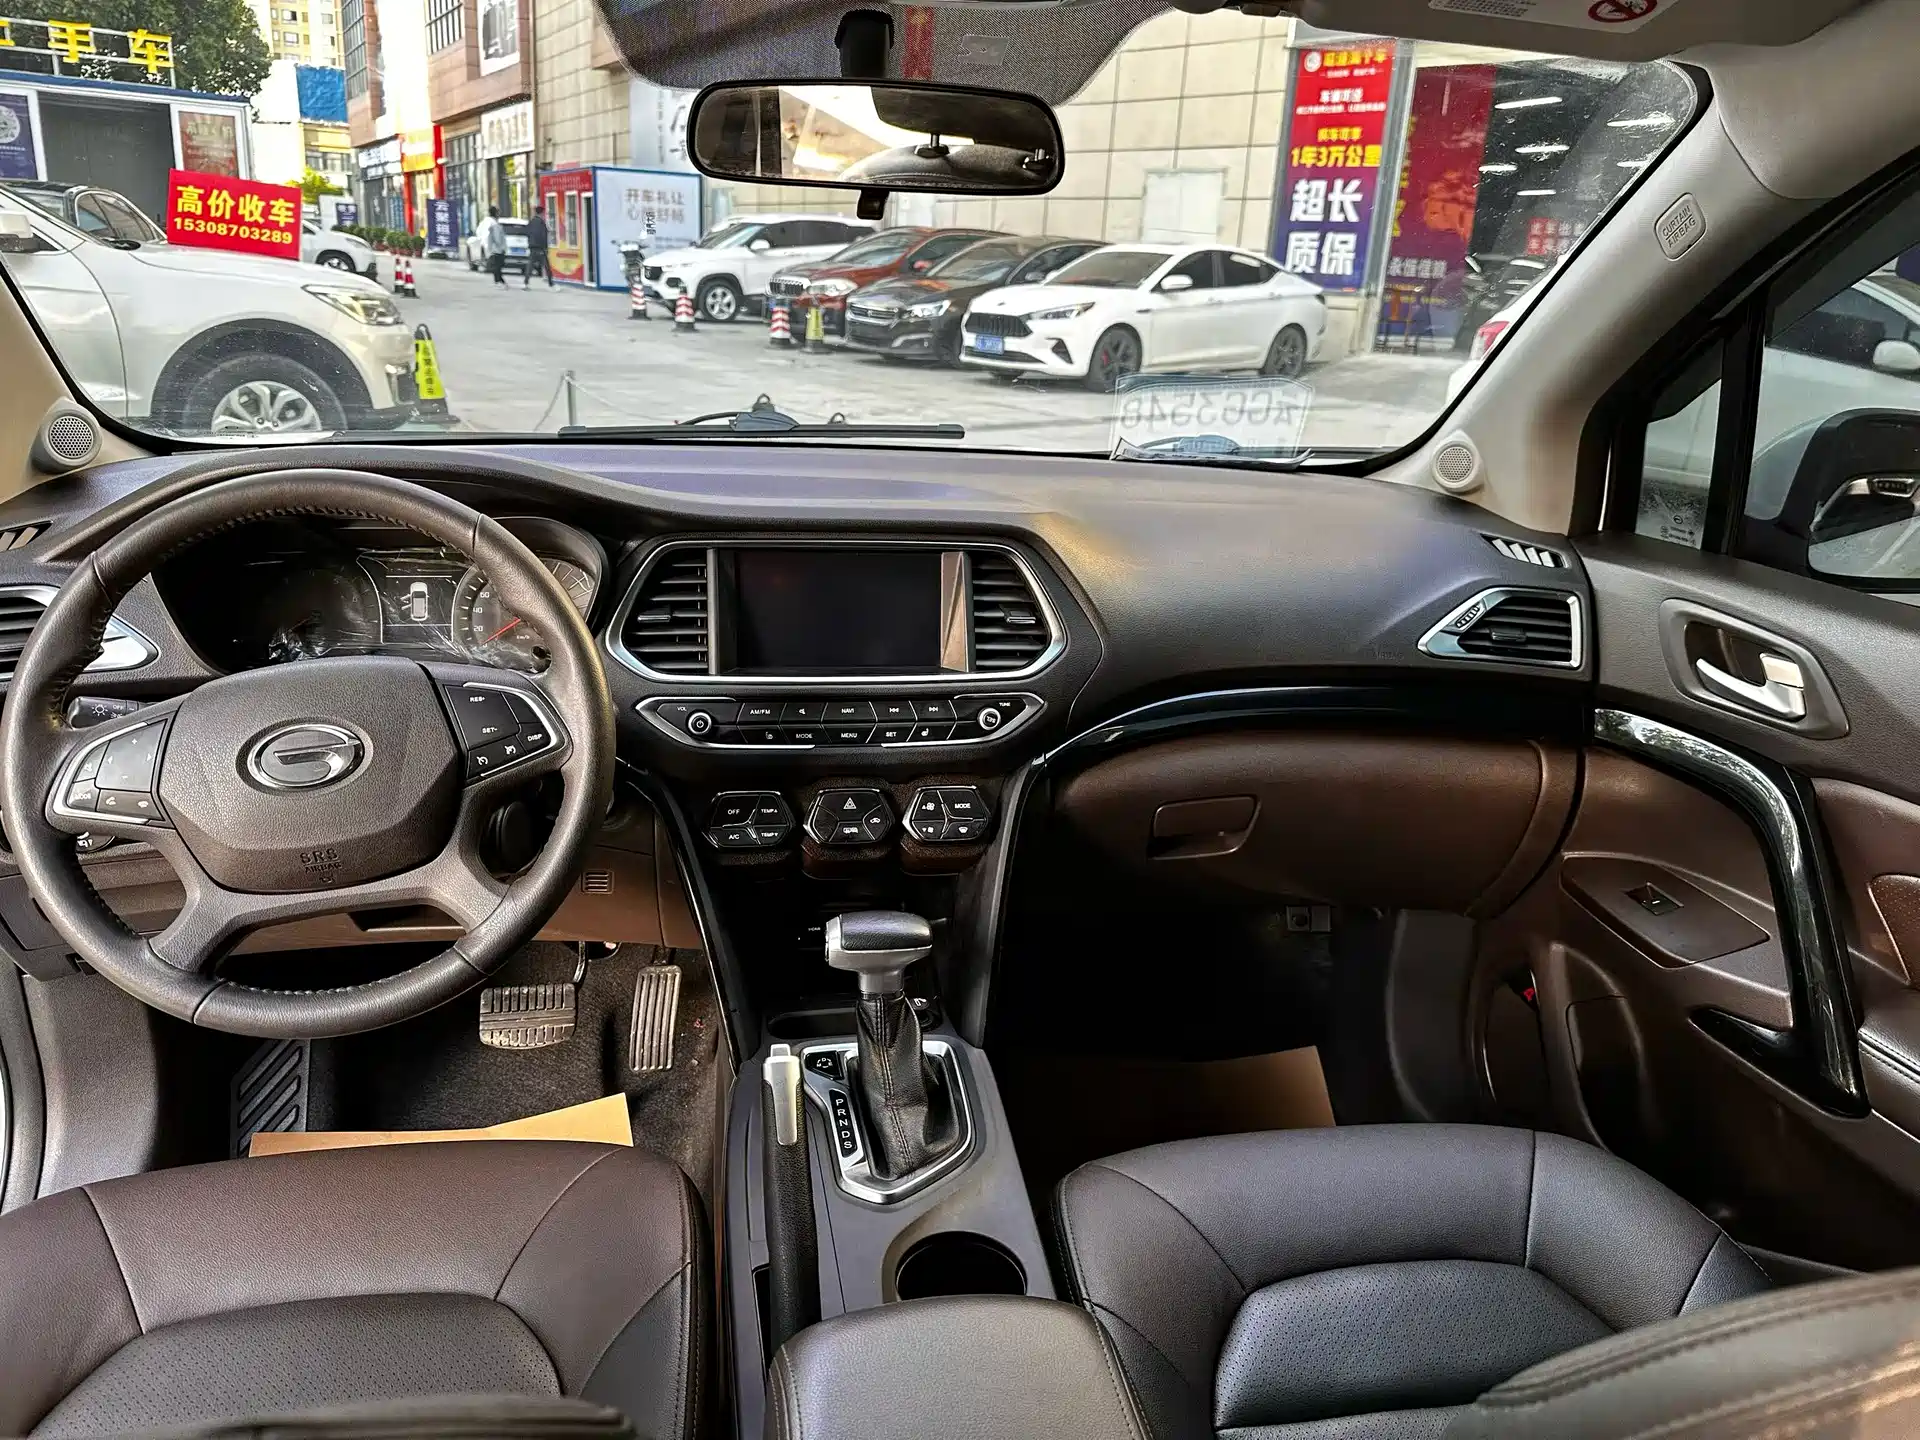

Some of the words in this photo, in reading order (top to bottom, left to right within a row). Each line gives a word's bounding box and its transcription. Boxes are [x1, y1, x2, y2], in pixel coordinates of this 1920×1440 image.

[1290, 144, 1383, 168] 1年3万公里
[176, 185, 295, 228] 高价收车
[1289, 178, 1364, 223] 超长
[174, 217, 293, 244] 15308703289
[1662, 205, 1691, 237] CURTAIN
[1667, 217, 1696, 248] AIRBAG
[1283, 231, 1358, 276] 质保
[527, 733, 543, 741] DISP
[300, 849, 339, 865] SRS
[304, 862, 342, 873] AIRBAG
